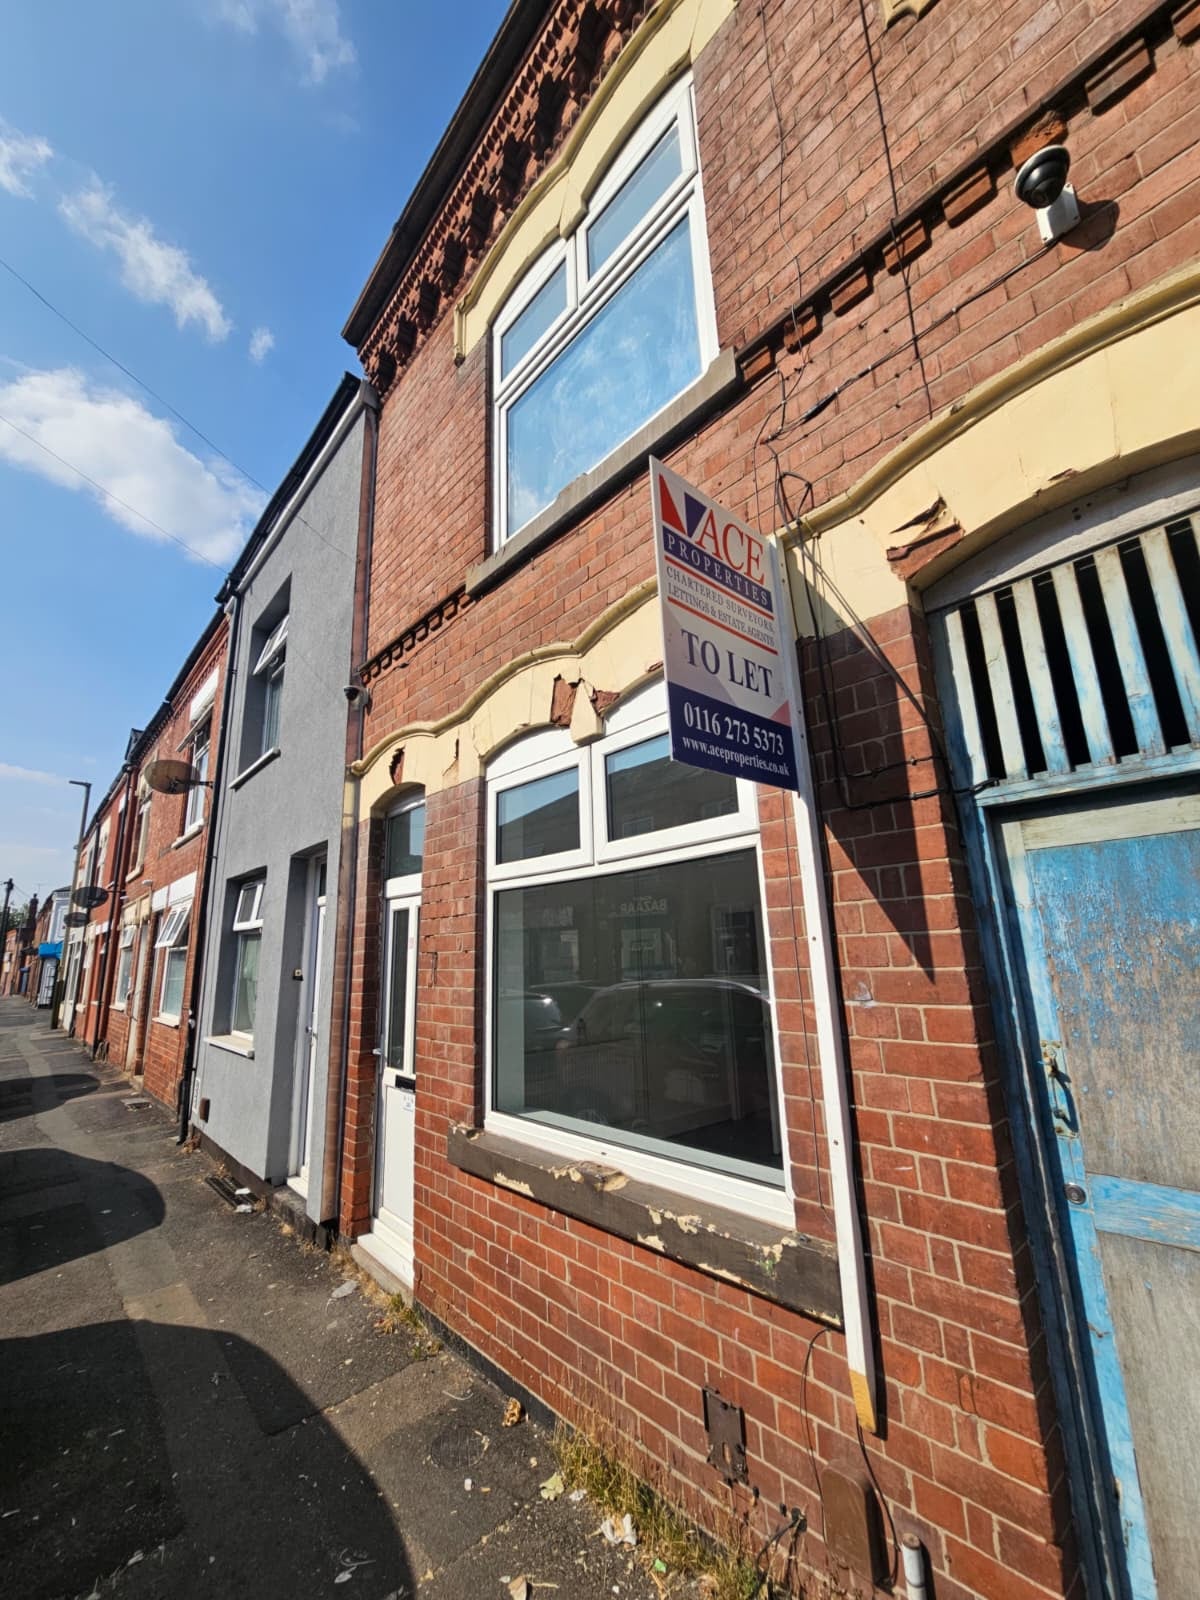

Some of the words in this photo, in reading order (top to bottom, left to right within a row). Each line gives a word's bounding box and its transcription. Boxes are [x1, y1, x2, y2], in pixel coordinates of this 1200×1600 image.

[668, 534, 768, 606] PROPERTIES
[695, 509, 765, 585] ACE
[666, 566, 724, 606] CHARTERED
[726, 600, 775, 633] SURVEYORS
[668, 583, 710, 615] LETTINGS
[710, 606, 717, 618] &
[718, 610, 748, 633] ESTATE
[748, 626, 775, 647] AGENTS
[681, 629, 720, 675] TO
[727, 650, 773, 697] LET
[682, 736, 790, 776] www.aceproperties.co.uk
[683, 701, 721, 736] 0116
[724, 716, 750, 745] 273
[753, 727, 784, 755] 5373
